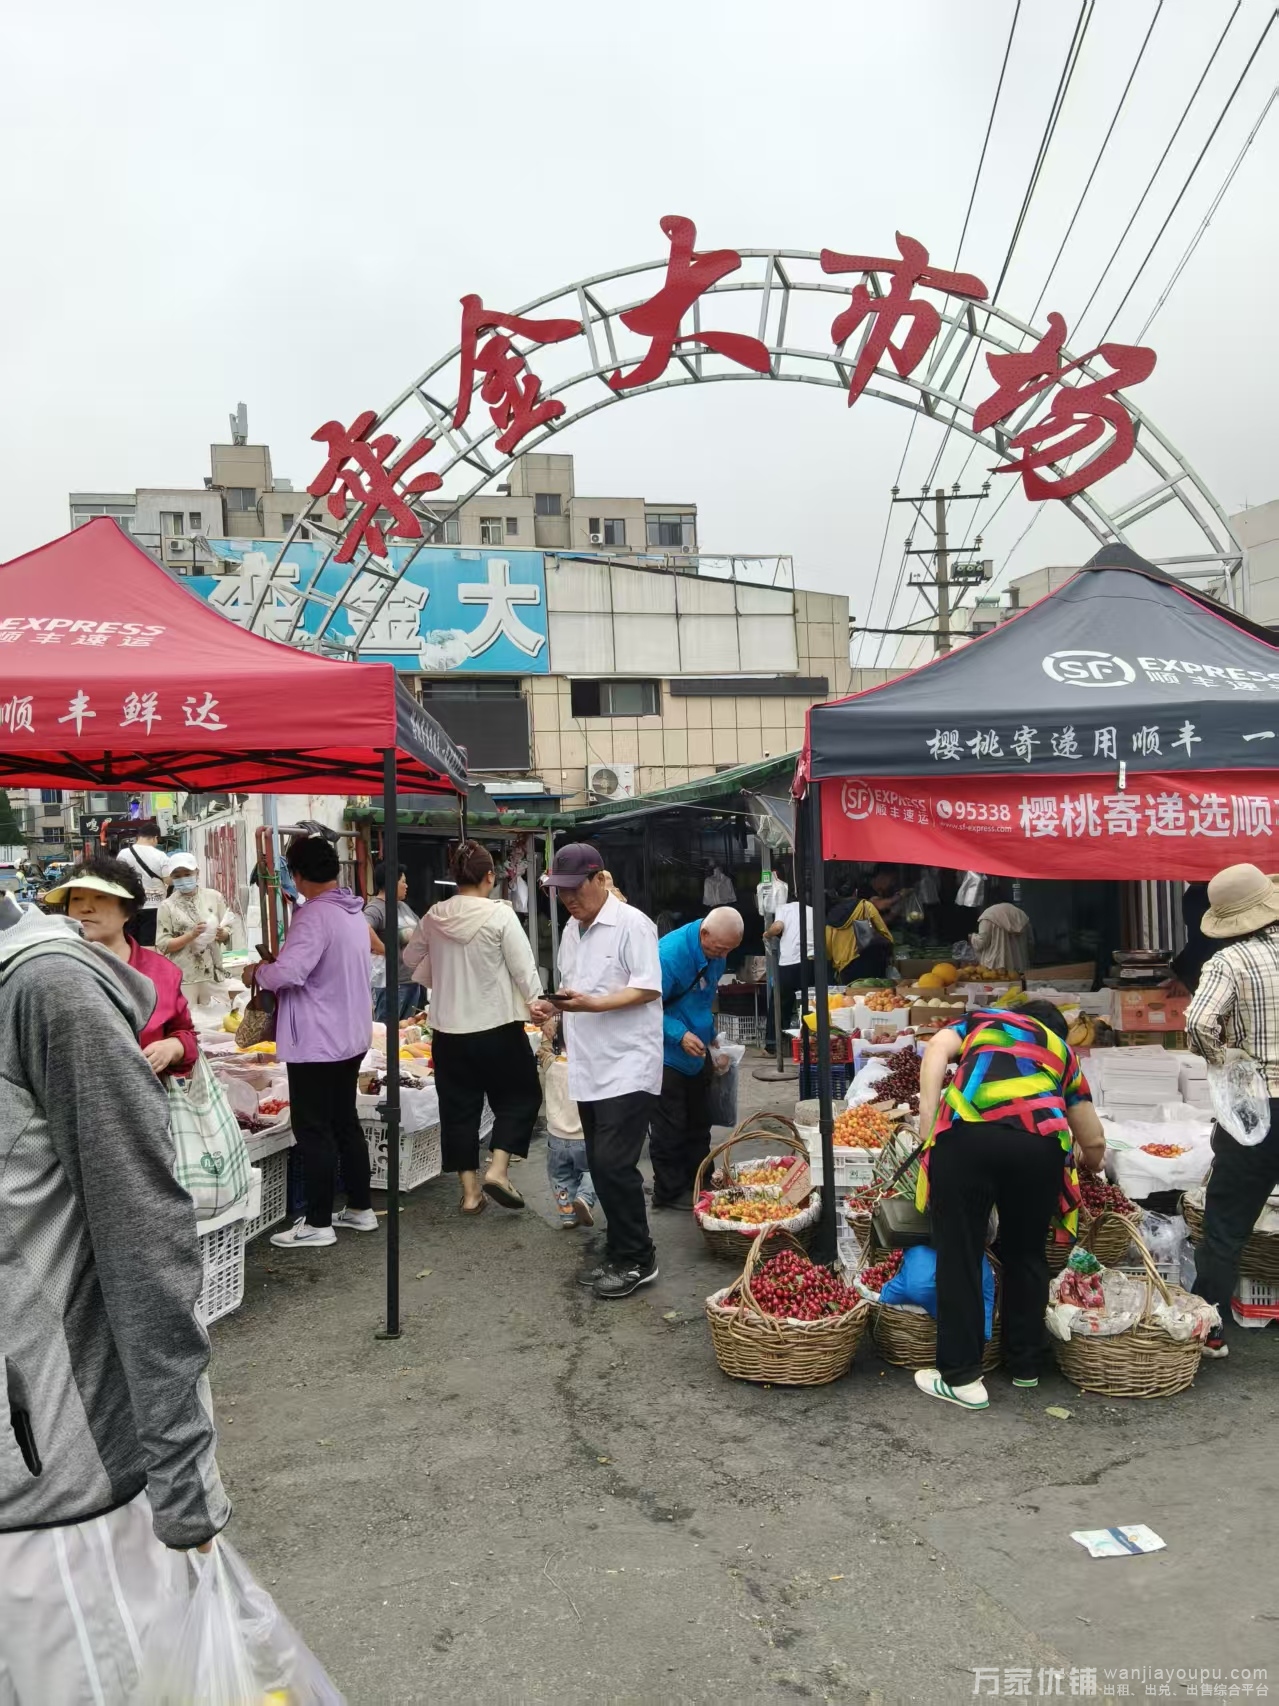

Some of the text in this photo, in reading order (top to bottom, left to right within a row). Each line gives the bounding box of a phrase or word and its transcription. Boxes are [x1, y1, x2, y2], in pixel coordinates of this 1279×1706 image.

[926, 719, 1202, 764] 樱桃寄递用顺丰
[874, 788, 927, 812] EXPRESS
[955, 801, 1011, 821] 95338
[875, 803, 929, 825] 顺丰速运
[940, 820, 1012, 833] www.sf-express.com
